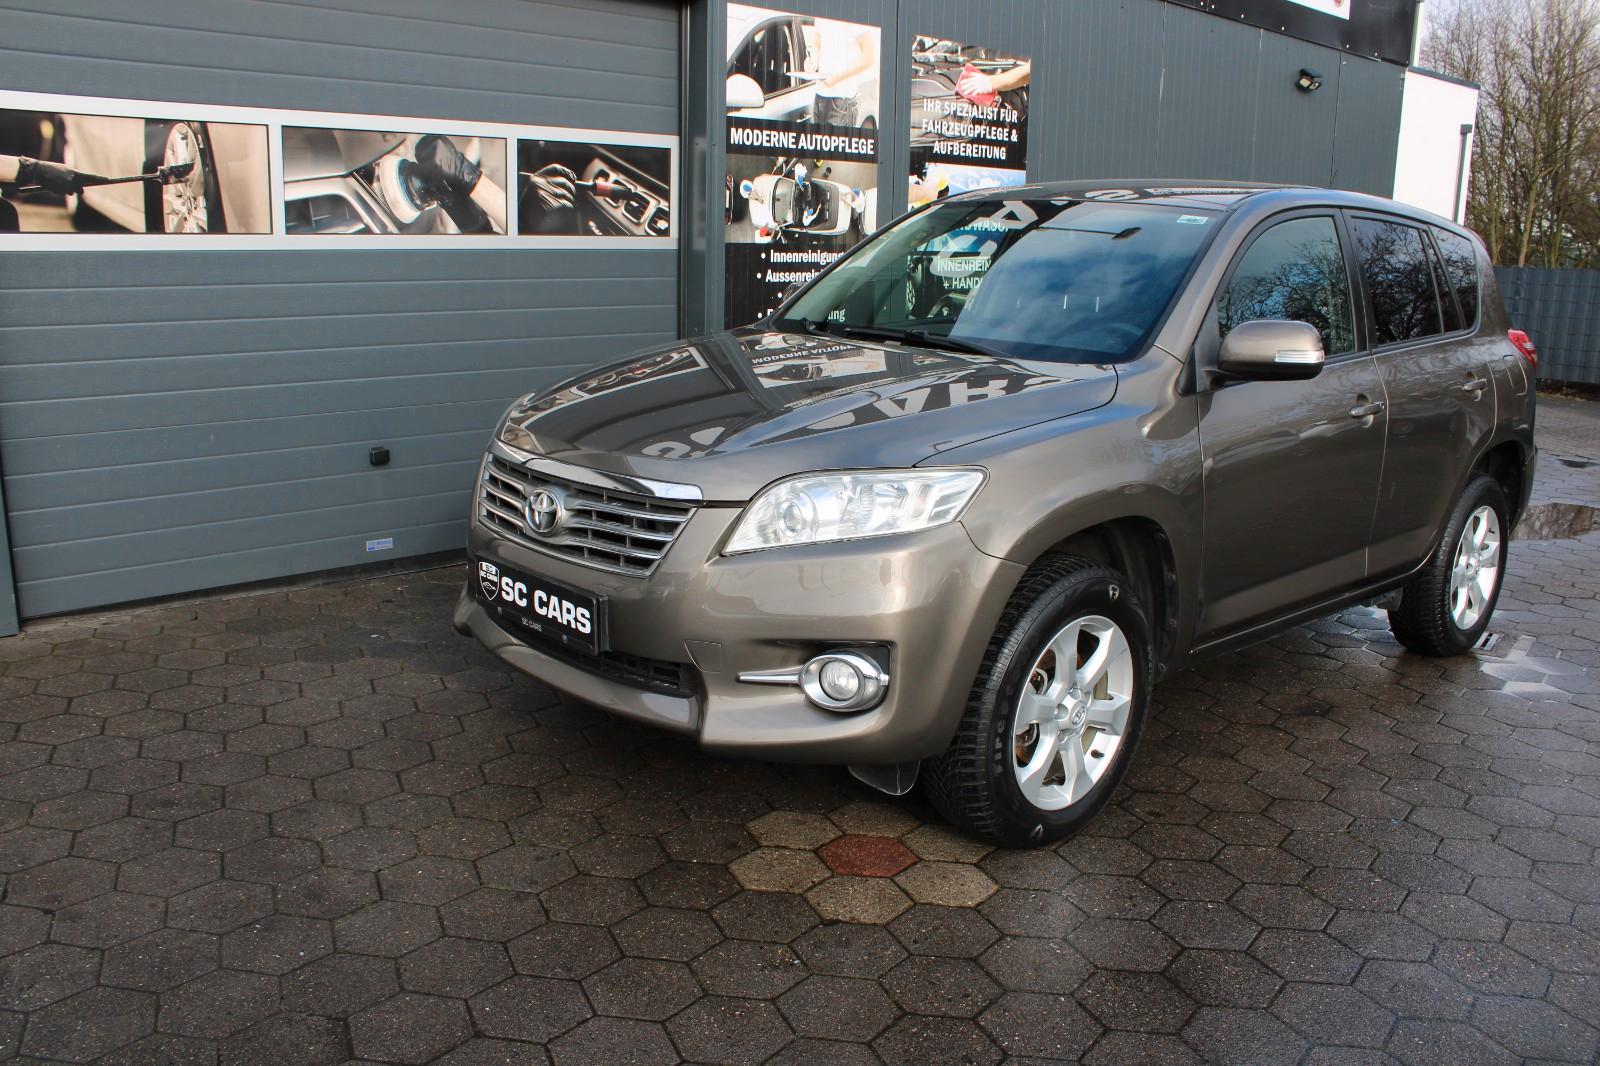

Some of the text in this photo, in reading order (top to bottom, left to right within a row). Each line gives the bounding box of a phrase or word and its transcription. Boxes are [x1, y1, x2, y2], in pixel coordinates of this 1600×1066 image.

[923, 97, 1018, 123] IHR SPEZIALIST FÜR
[730, 127, 875, 155] MODERNE AUTOPFLEGE
[922, 118, 1018, 142] FAHRZEUGPFLEGE &
[933, 140, 1006, 160] AUFBEREITUNG
[952, 276, 983, 289] HAND
[501, 576, 591, 634] SC CARS
